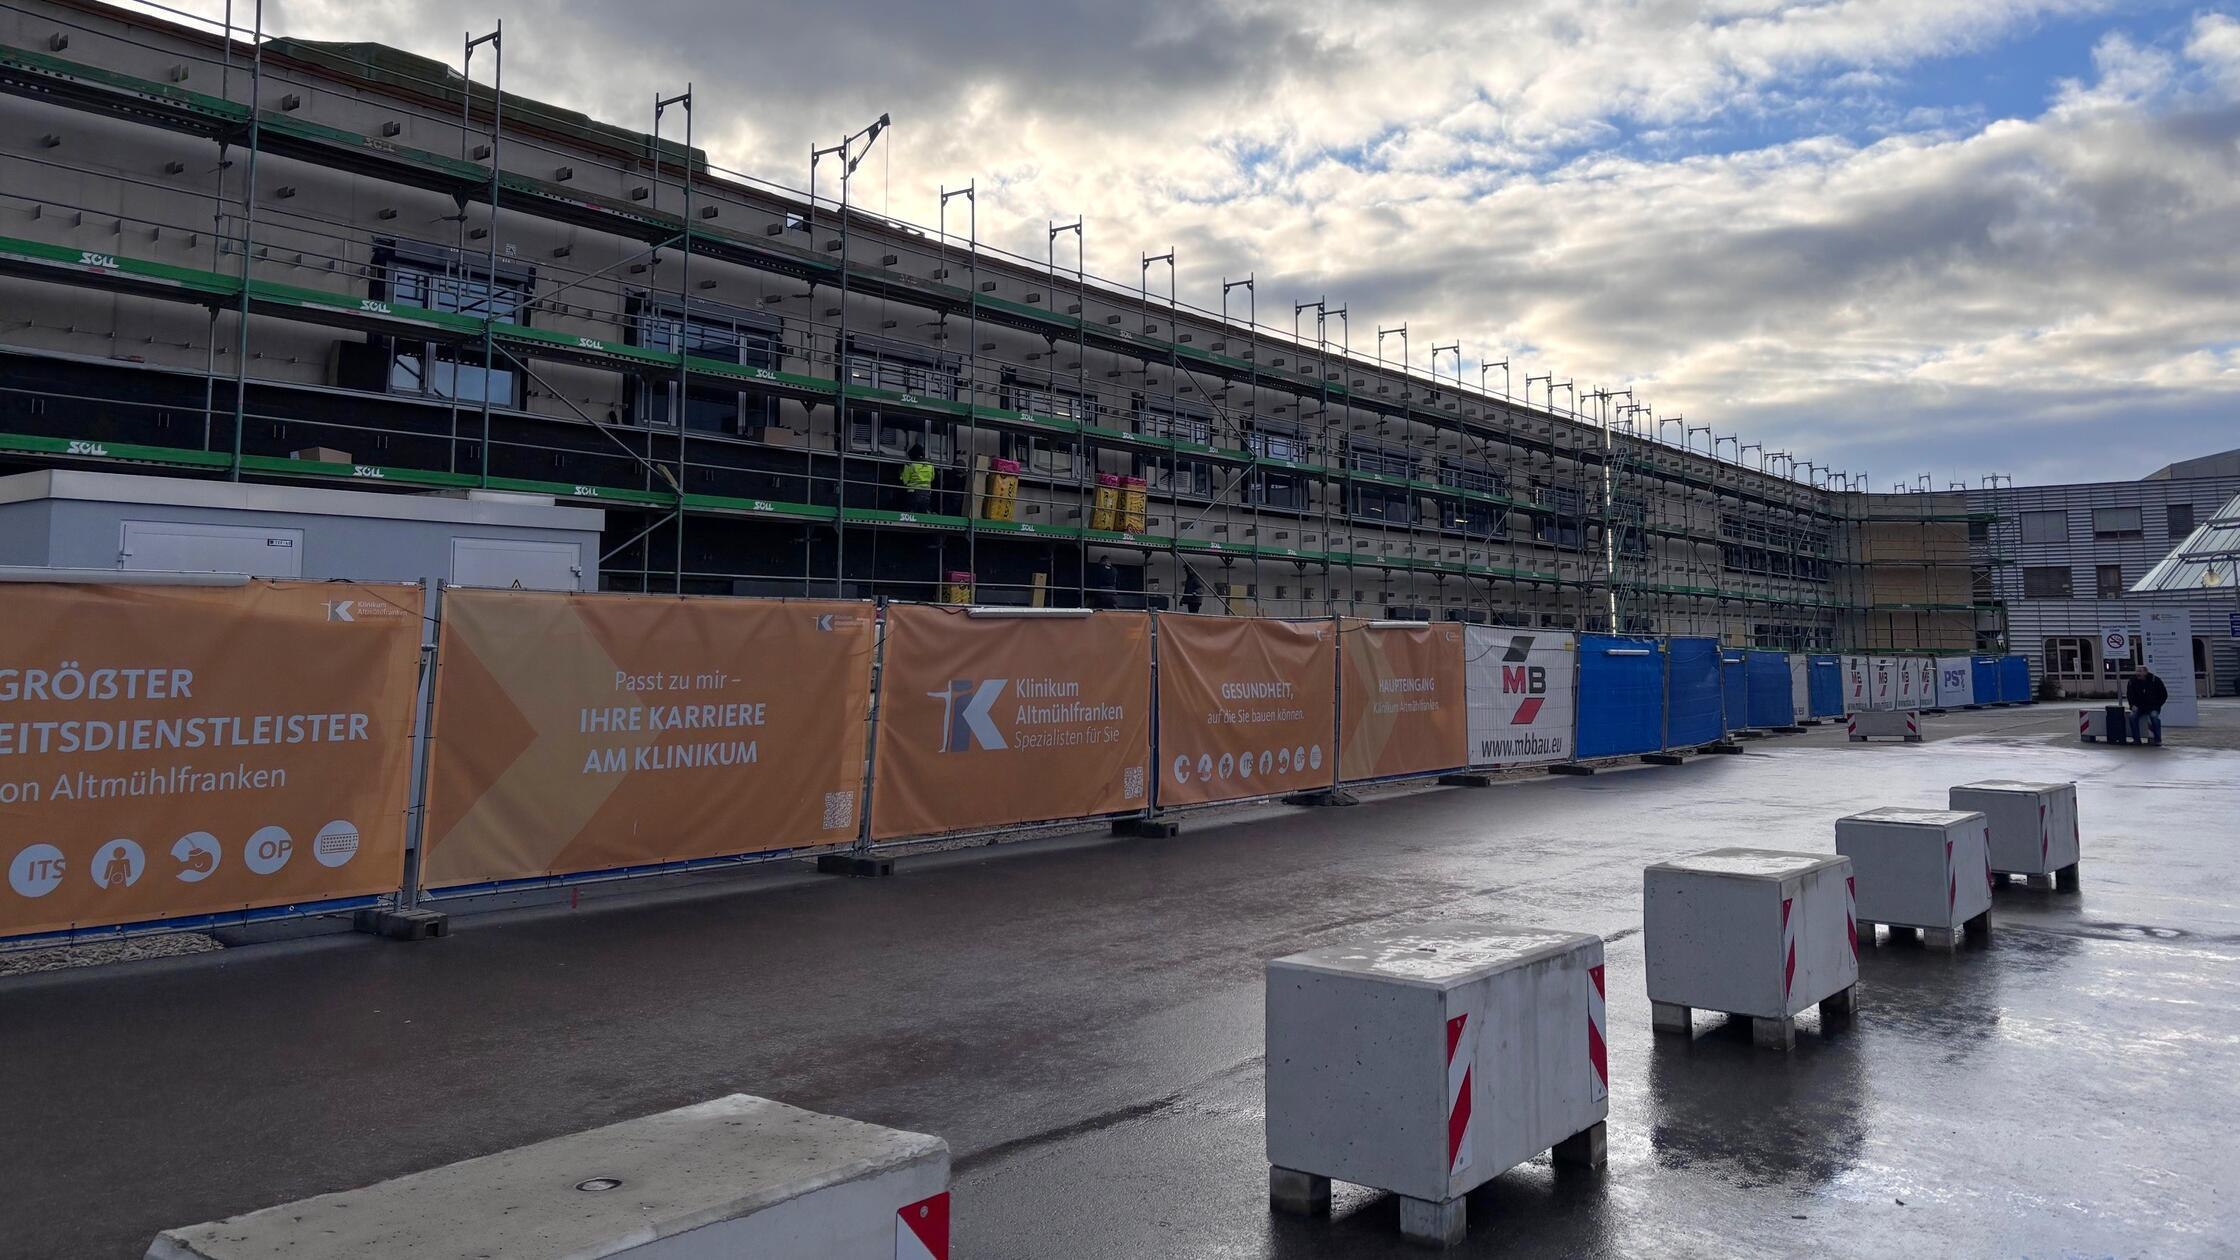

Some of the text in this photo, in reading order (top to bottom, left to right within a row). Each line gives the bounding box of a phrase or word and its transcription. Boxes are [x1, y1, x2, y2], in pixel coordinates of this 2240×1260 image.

[615, 671, 663, 691] Passt
[668, 675, 690, 690] zu
[696, 670, 727, 689] mir
[1016, 678, 1079, 698] Klinikum
[1222, 681, 1294, 700] GESUNDHEIT,
[1503, 666, 1547, 694] MB
[579, 703, 767, 733] IHRE KARRIERE
[1016, 703, 1124, 725] Altmühlfranken
[1014, 726, 1120, 752] Spezialisten für Sie
[1482, 733, 1562, 757] www.mbbau.eu
[582, 741, 759, 774] AM KLINIKUM
[50, 763, 286, 801] Altmühlfranken
[258, 839, 292, 861] OP
[28, 859, 66, 882] ITS
